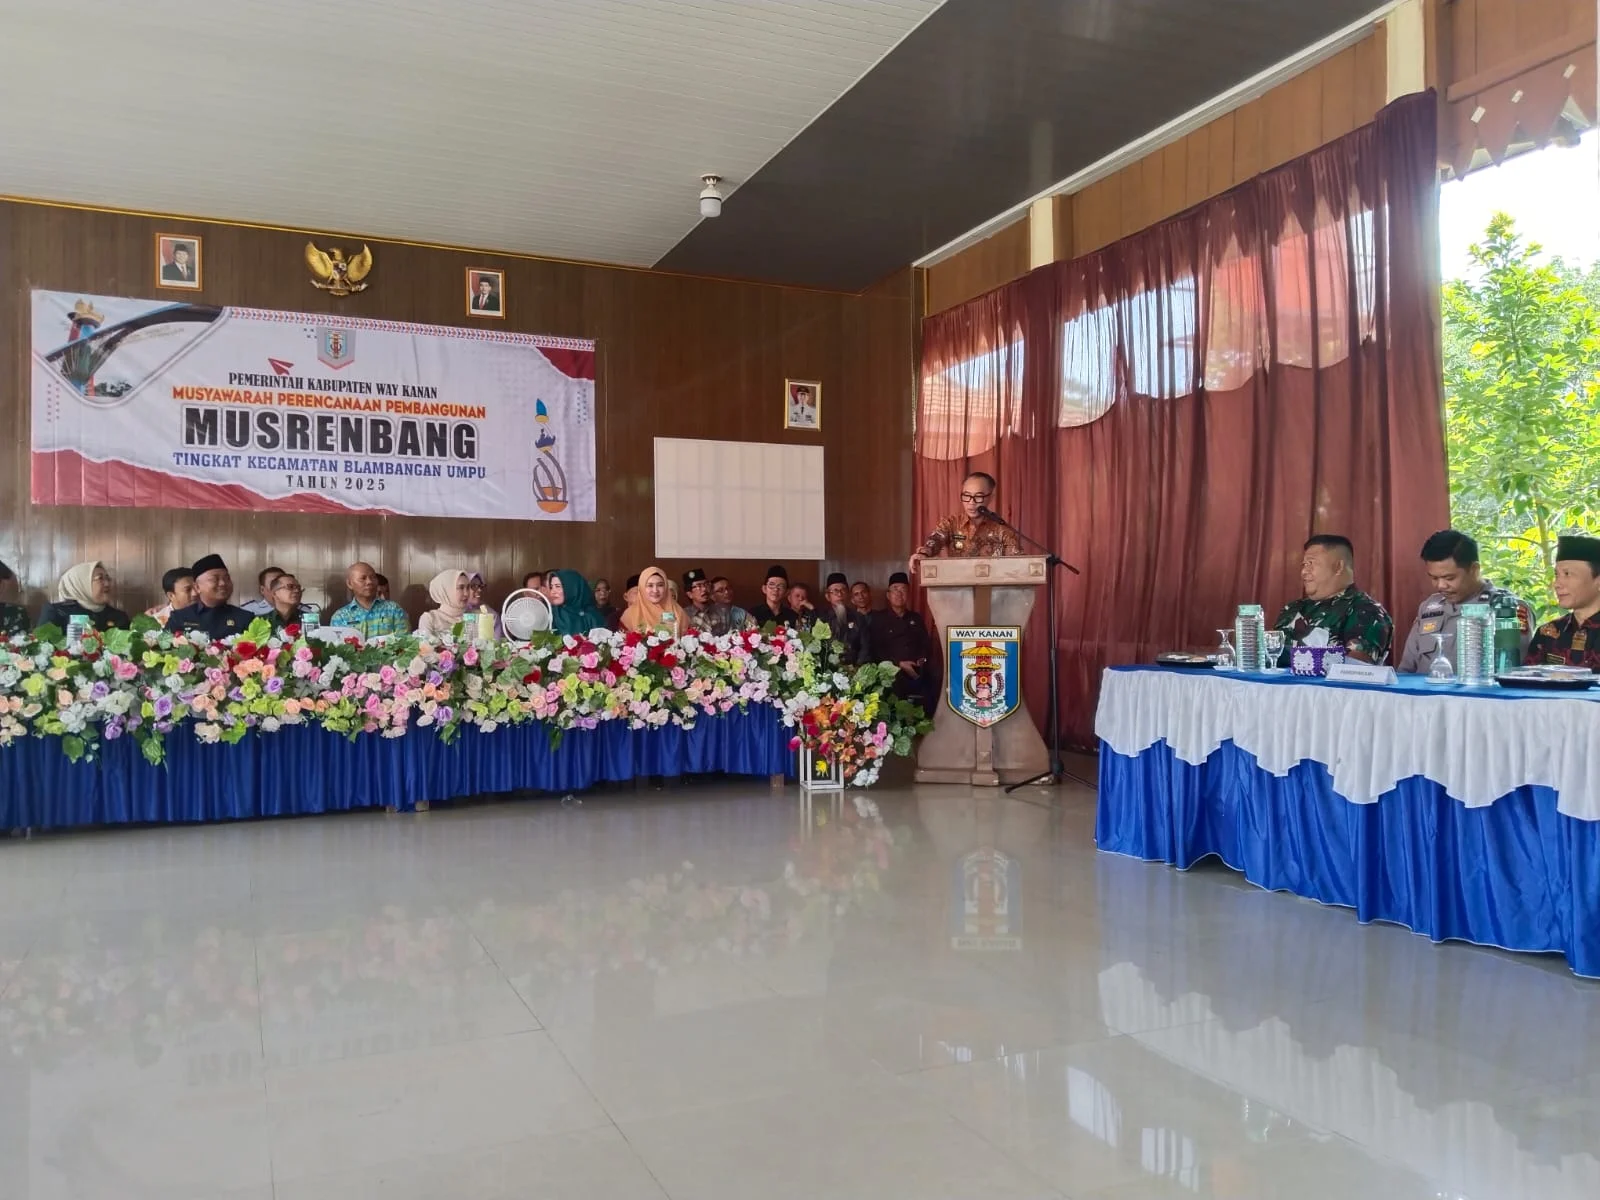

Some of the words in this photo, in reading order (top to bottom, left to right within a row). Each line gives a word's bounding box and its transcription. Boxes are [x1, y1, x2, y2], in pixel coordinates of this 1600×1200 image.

[228, 372, 304, 390] PEMERINTAH
[307, 378, 372, 394] KABUPATEN
[376, 383, 399, 397] WAY
[402, 385, 438, 399] KANAN
[172, 386, 273, 405] MUSYAWARAH
[278, 393, 382, 412] PERENCANAAN
[386, 400, 486, 419] PEMBANGUNAN
[184, 407, 477, 460] MUSRENBANG
[173, 452, 242, 468] TINGKAT
[247, 456, 338, 473] KECAMATAN
[344, 460, 441, 477] BLAMBANGAN
[447, 465, 486, 479] UMPU
[286, 475, 338, 489] TAHUN
[345, 477, 385, 491] 2025
[956, 630, 977, 638] WAY
[978, 630, 1013, 638] KANAN
